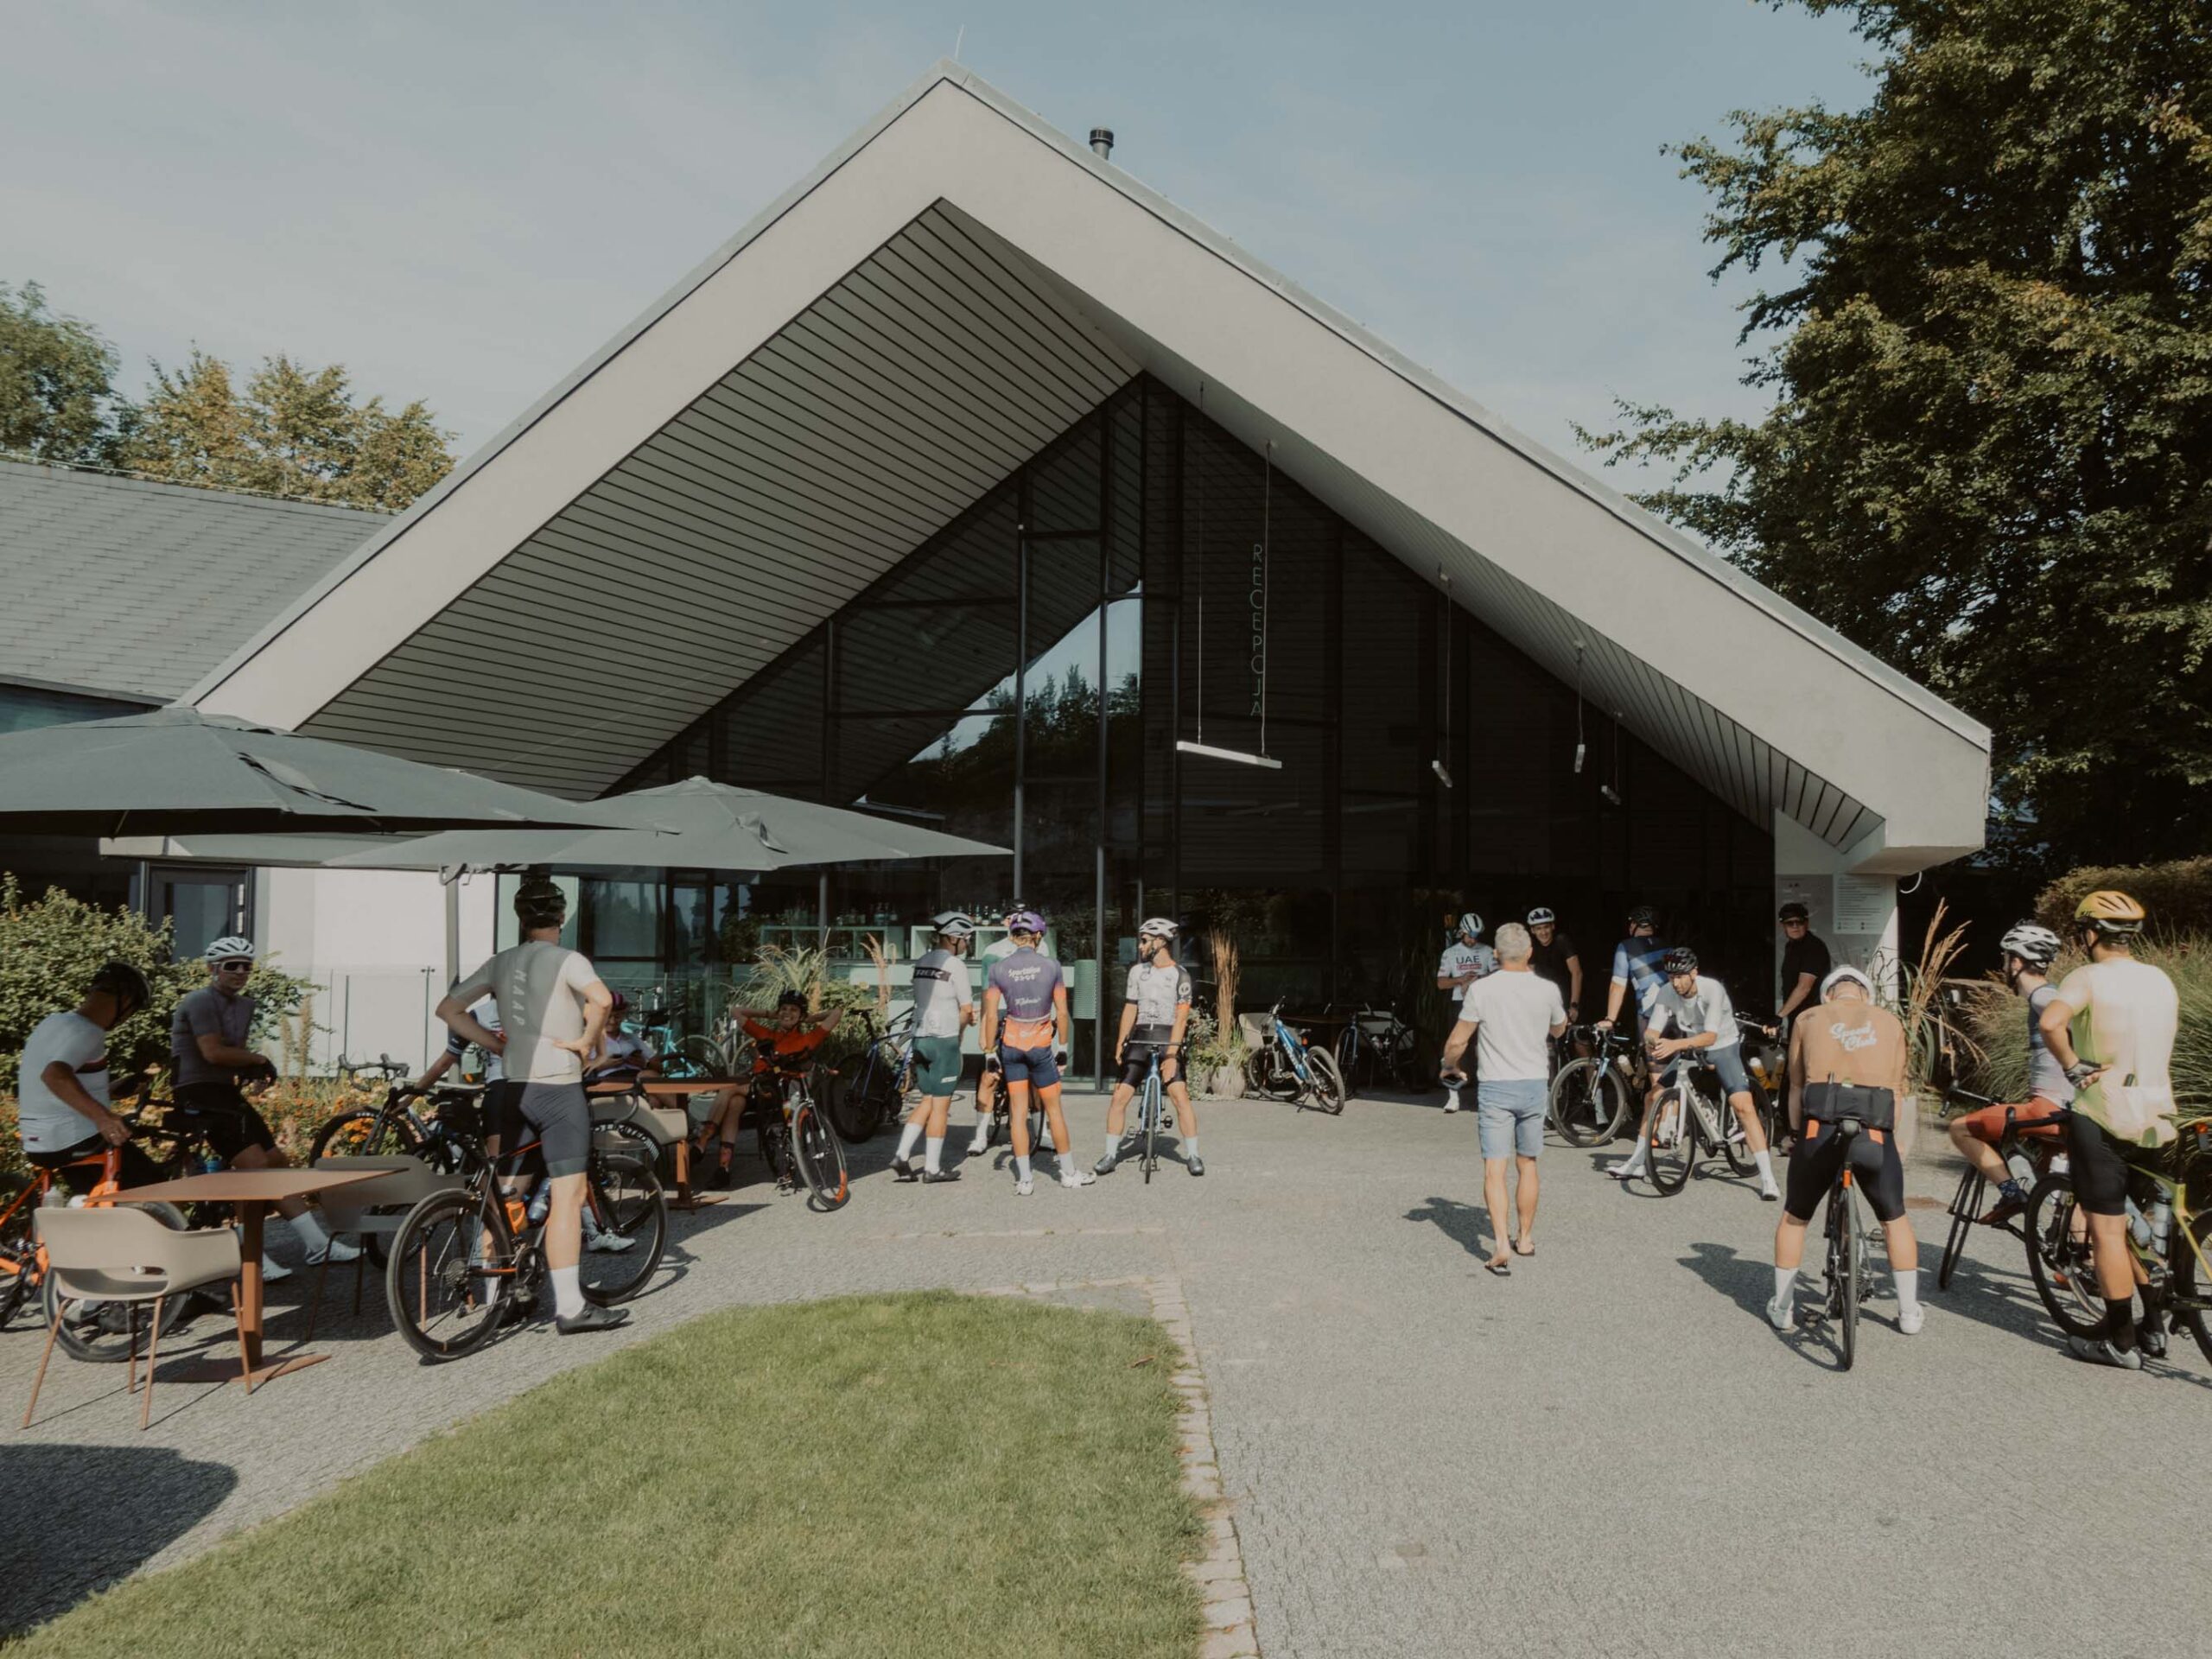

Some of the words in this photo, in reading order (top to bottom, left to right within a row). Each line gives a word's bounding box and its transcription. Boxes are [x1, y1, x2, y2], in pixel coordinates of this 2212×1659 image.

[1249, 543, 1265, 717] RECEPCJA
[1456, 955, 1480, 964] UAE
[512, 969, 527, 1027] MAAP
